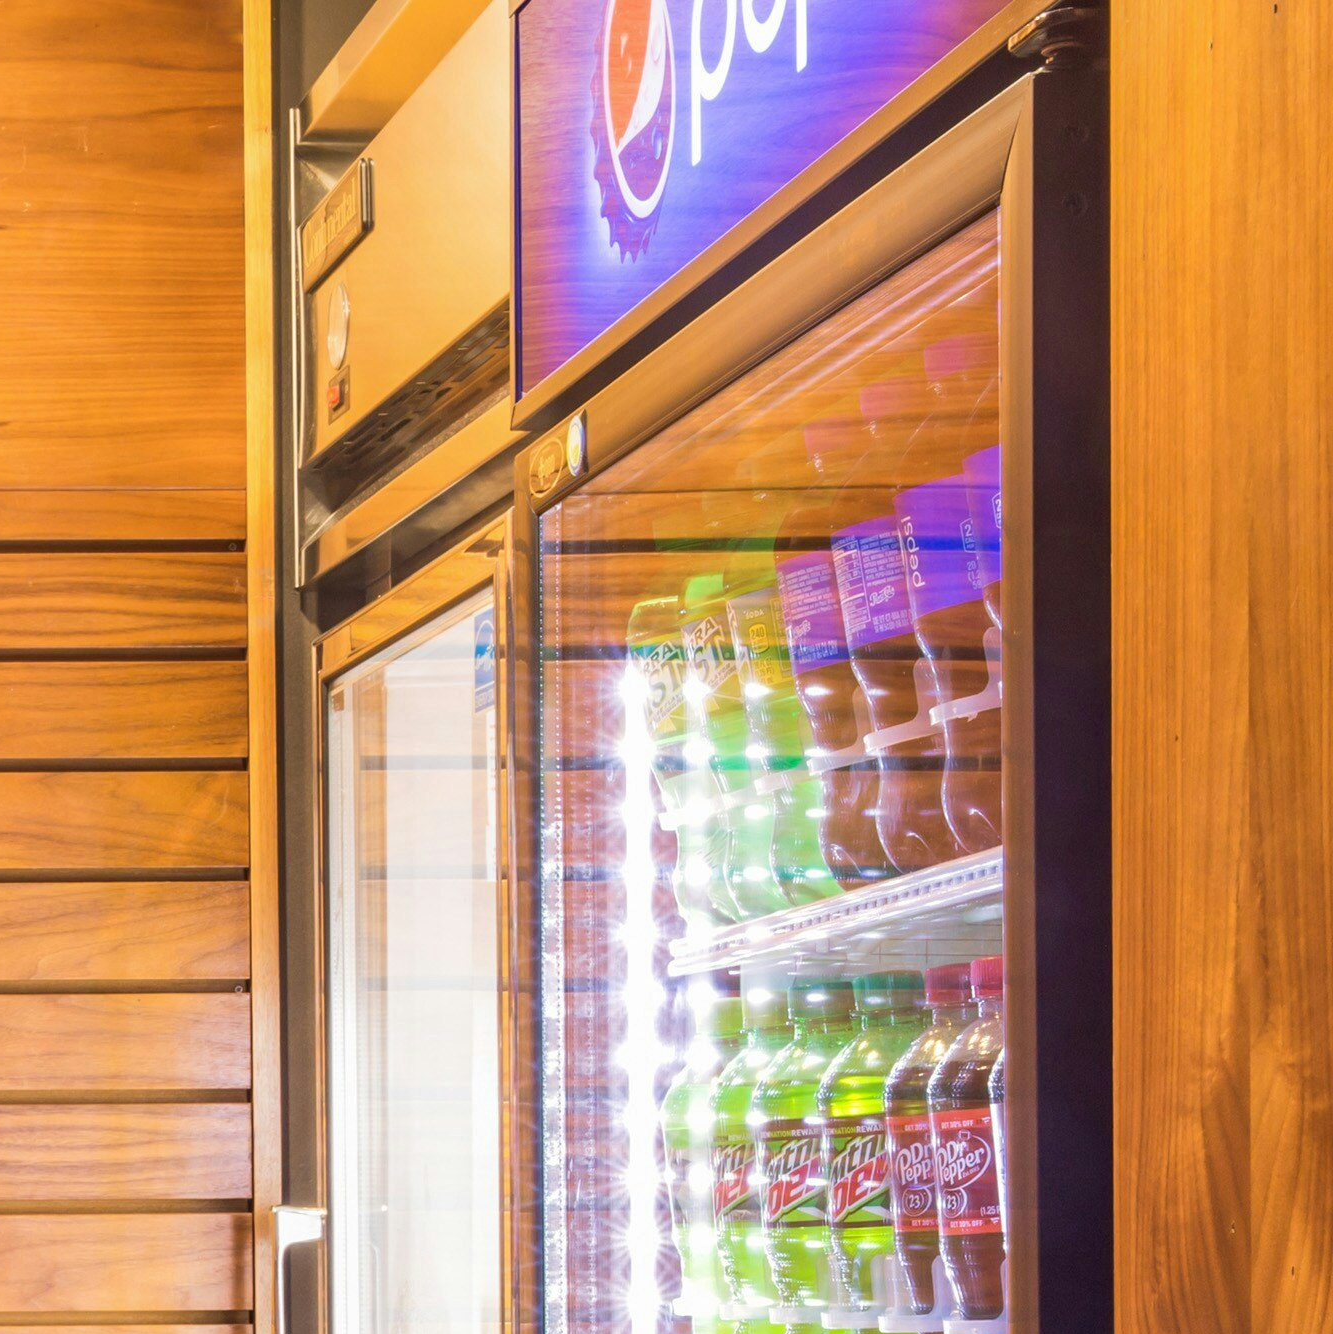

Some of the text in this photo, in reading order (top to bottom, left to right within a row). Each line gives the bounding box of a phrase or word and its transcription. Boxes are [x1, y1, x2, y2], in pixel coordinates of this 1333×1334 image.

[900, 515, 926, 589] pepsi
[751, 627, 765, 639] 240
[946, 1140, 968, 1161] Dr
[936, 1147, 985, 1185] Pepper
[908, 1195, 920, 1209] 23
[946, 1195, 957, 1210] 23
